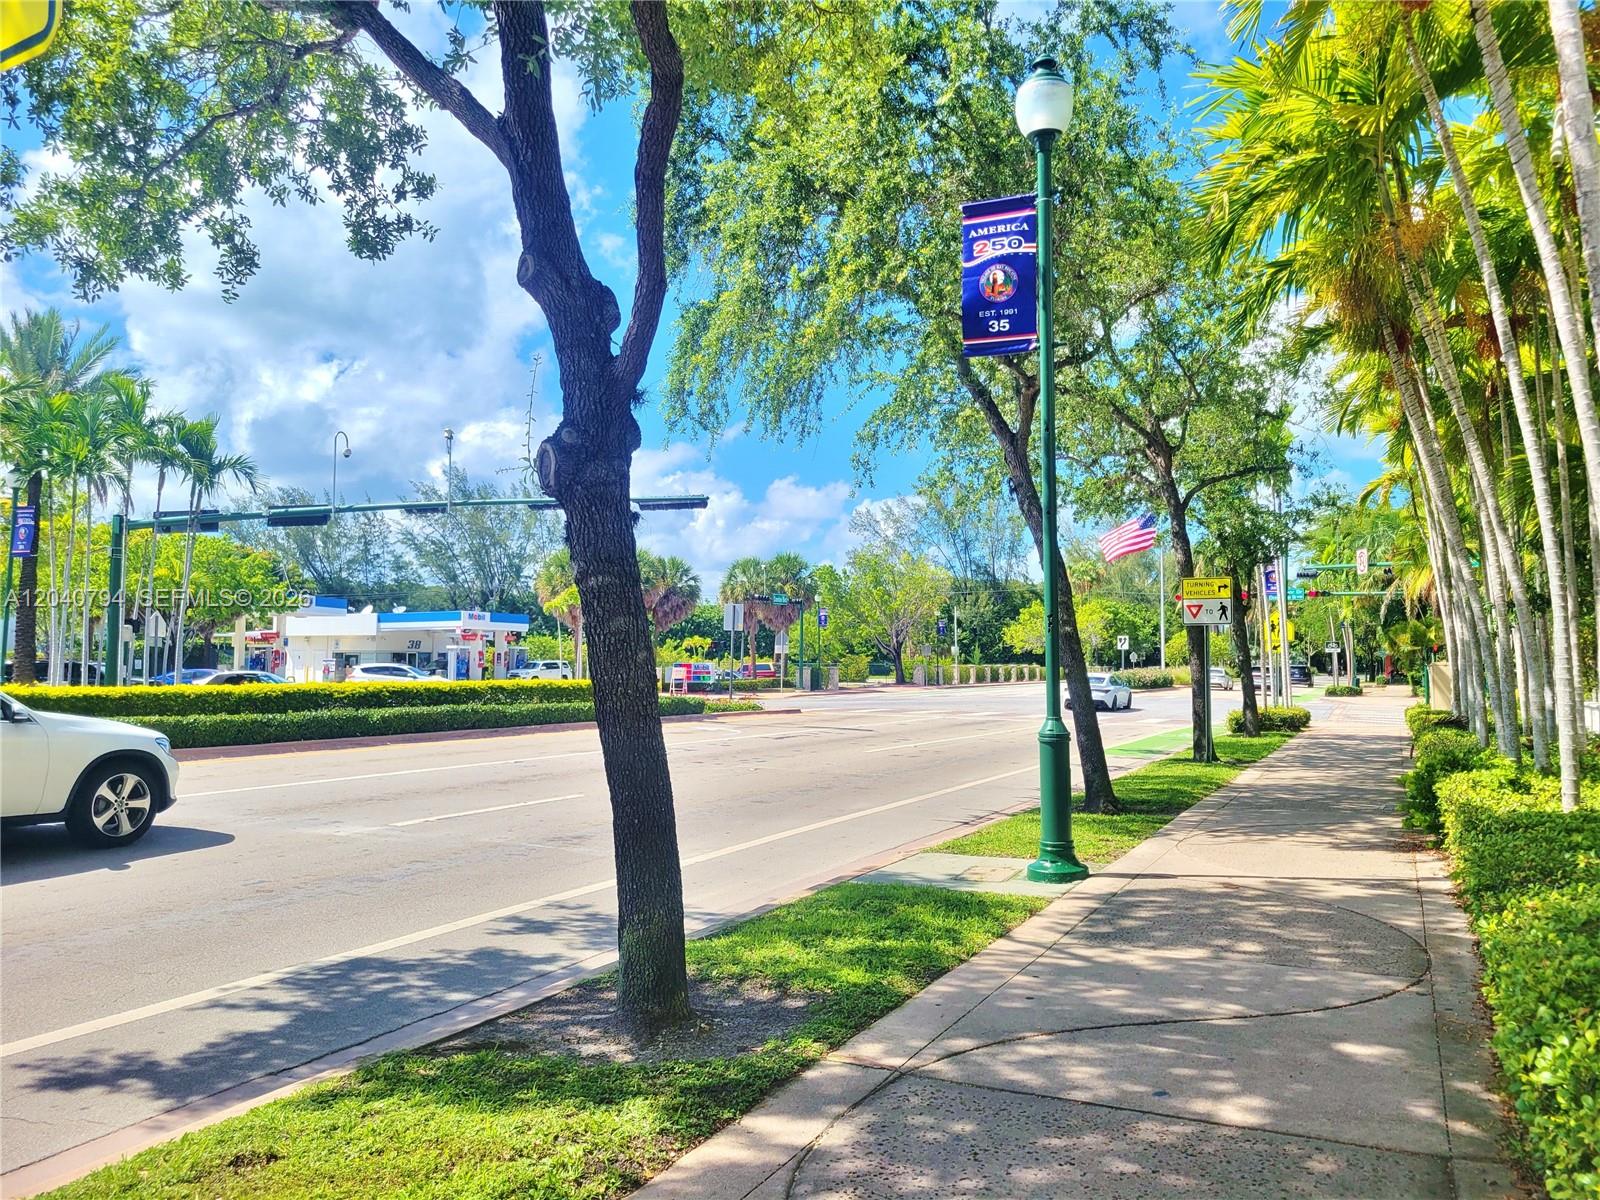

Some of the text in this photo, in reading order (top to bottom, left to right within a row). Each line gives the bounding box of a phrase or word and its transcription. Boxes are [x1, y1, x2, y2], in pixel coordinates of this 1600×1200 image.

[969, 223, 1029, 238] AMERICA
[973, 236, 1024, 257] 250
[978, 308, 1018, 318] EST. 1991
[988, 319, 1010, 333] 35
[468, 612, 486, 620] Mobil
[407, 639, 422, 650] 38
